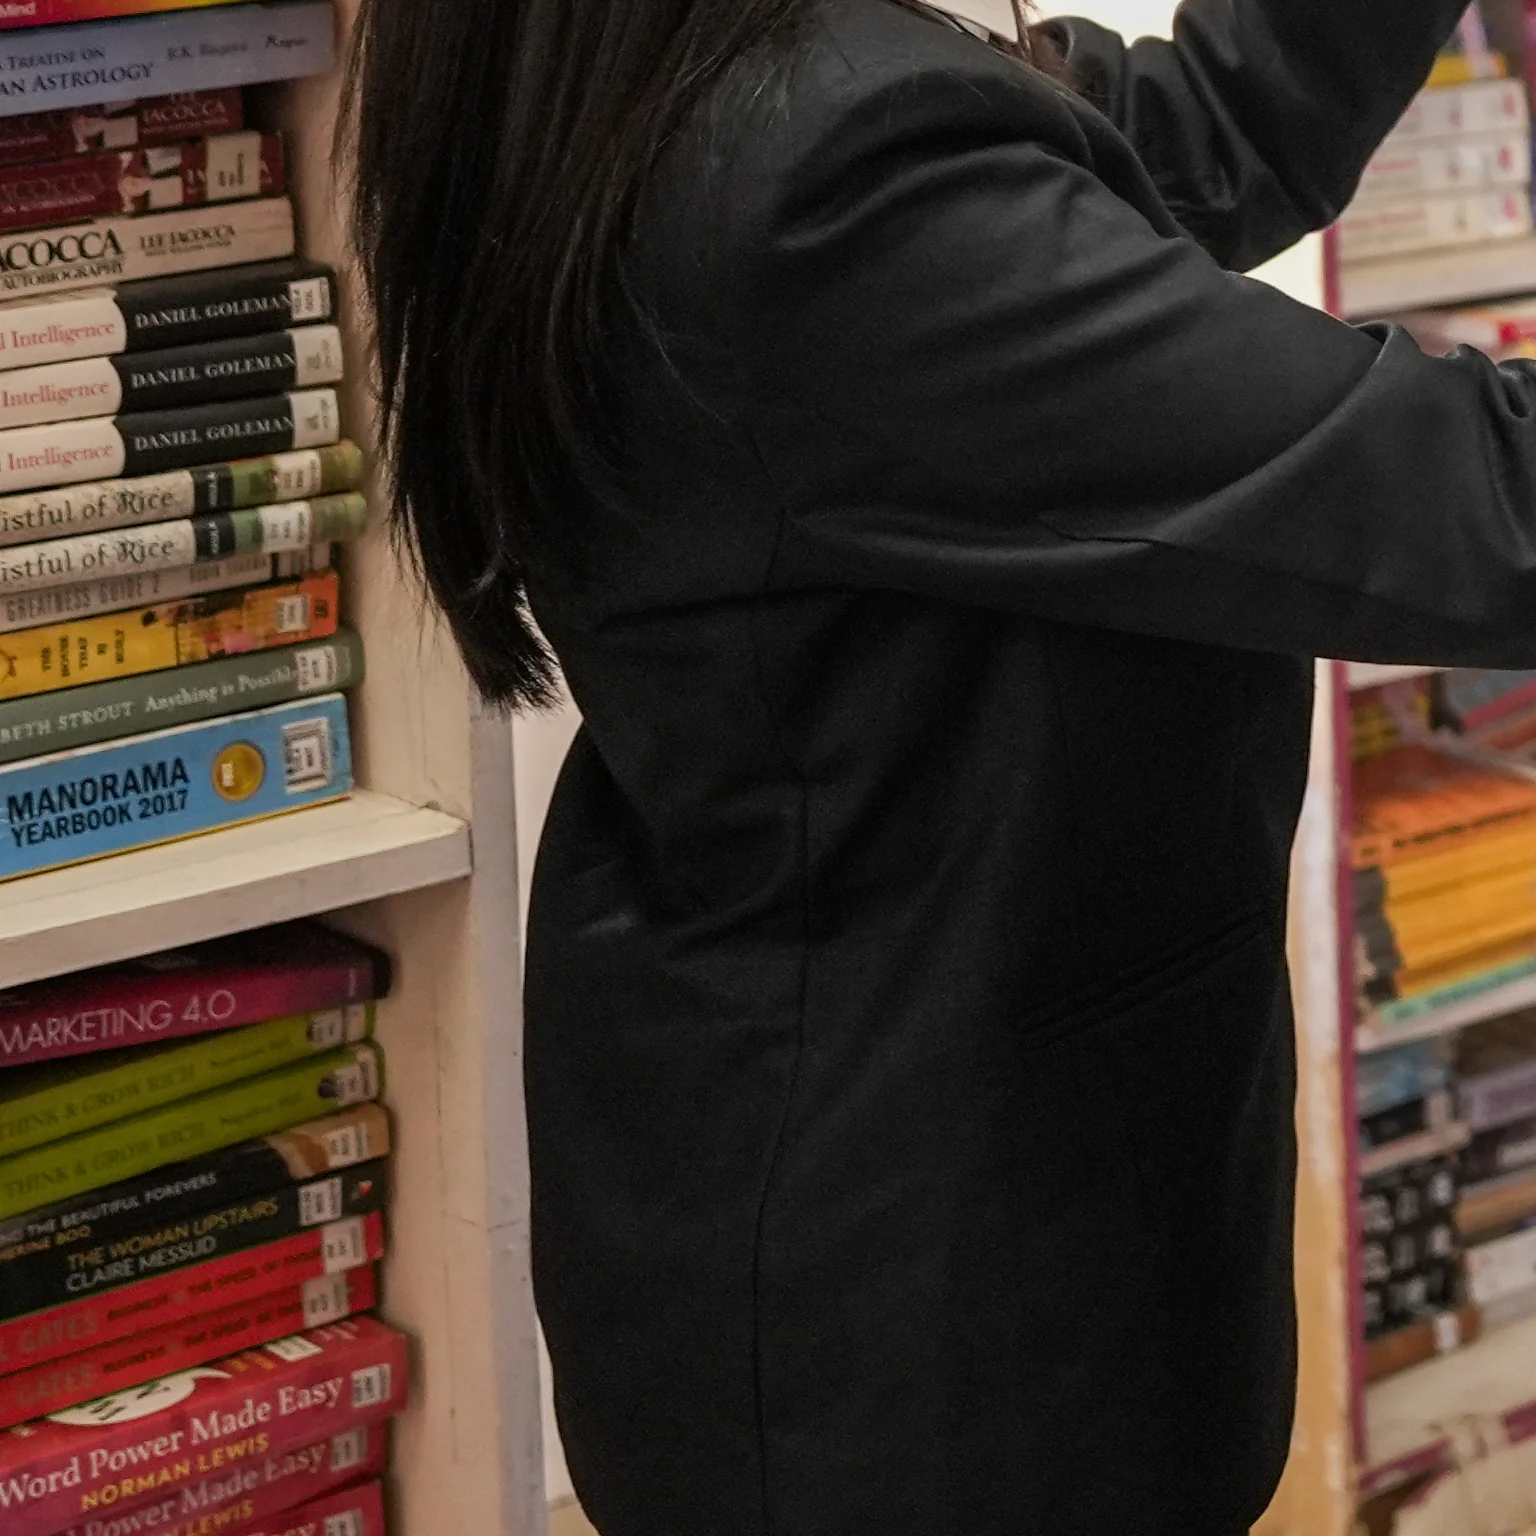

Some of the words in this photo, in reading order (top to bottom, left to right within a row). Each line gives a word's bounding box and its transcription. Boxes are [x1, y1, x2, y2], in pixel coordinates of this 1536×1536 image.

[32, 63, 154, 92] ASTROLOGY
[12, 321, 115, 349] Intelligence
[134, 306, 201, 329] DANIEL
[205, 292, 293, 317] GOLEMAN
[3, 381, 109, 409] Intelligence
[131, 365, 200, 390] DANIEL
[204, 352, 296, 379] GOLEMAN
[8, 444, 114, 472] Intelligence
[132, 428, 200, 453] DANIEL
[205, 416, 295, 441] GOLEMAN
[82, 492, 108, 521] of
[115, 488, 175, 514] Rice
[82, 543, 108, 570] of
[116, 538, 175, 564] Rice
[58, 701, 133, 730] STROUT
[146, 685, 218, 715] Anything
[7, 758, 190, 825] MANORAMA
[11, 801, 134, 848] YEARBOOK
[139, 790, 189, 820] 2017
[0, 998, 172, 1056] MARKETING
[182, 989, 236, 1022] 4.0
[65, 1258, 135, 1292] CLAIRE
[139, 1235, 217, 1269] MESSUD
[19, 1313, 98, 1355] GATES
[0, 1457, 82, 1508] Word
[88, 1430, 185, 1479] Power
[190, 1399, 272, 1446] Made
[278, 1375, 344, 1415] Easy
[81, 1460, 192, 1512] NORMAN
[196, 1431, 270, 1473] LEWIS
[180, 1467, 259, 1514] Made
[264, 1439, 328, 1484] Easy
